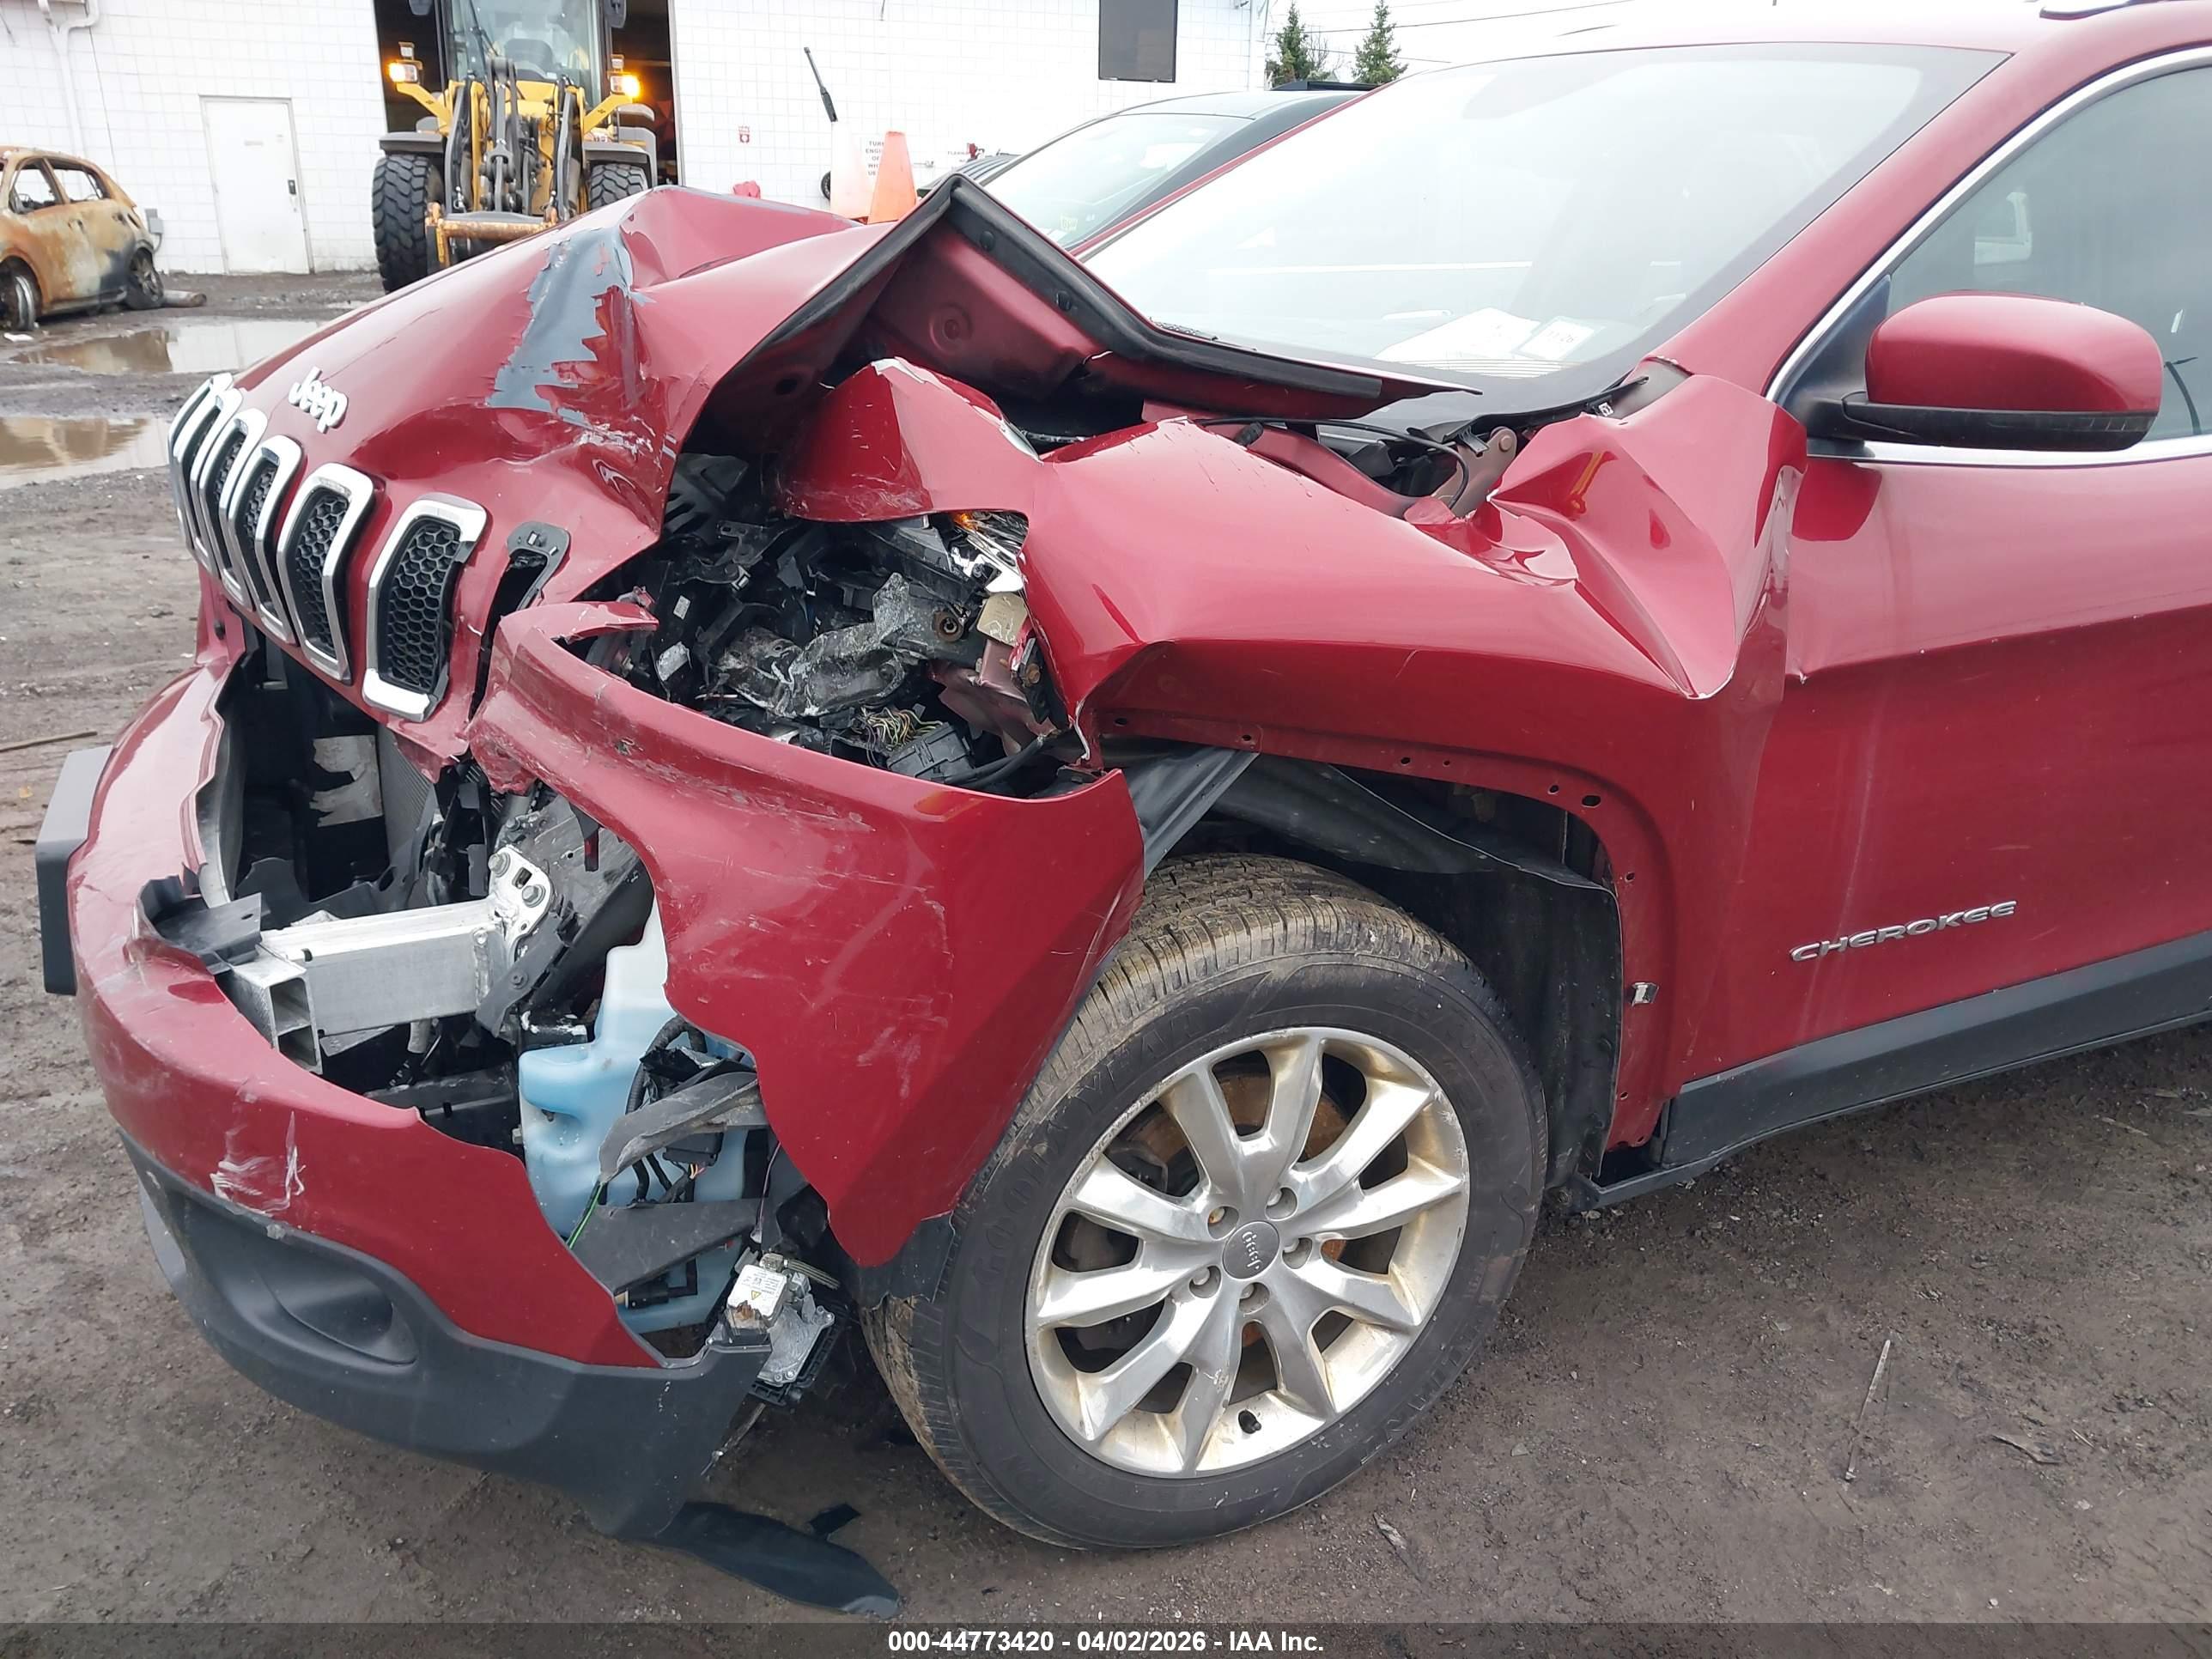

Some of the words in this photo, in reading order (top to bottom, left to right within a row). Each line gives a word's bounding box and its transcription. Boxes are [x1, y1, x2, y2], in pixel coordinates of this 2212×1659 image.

[289, 366, 348, 434] Jeep
[1790, 900, 2017, 961] CHEROKEE
[1242, 1231, 1262, 1271] Jeep
